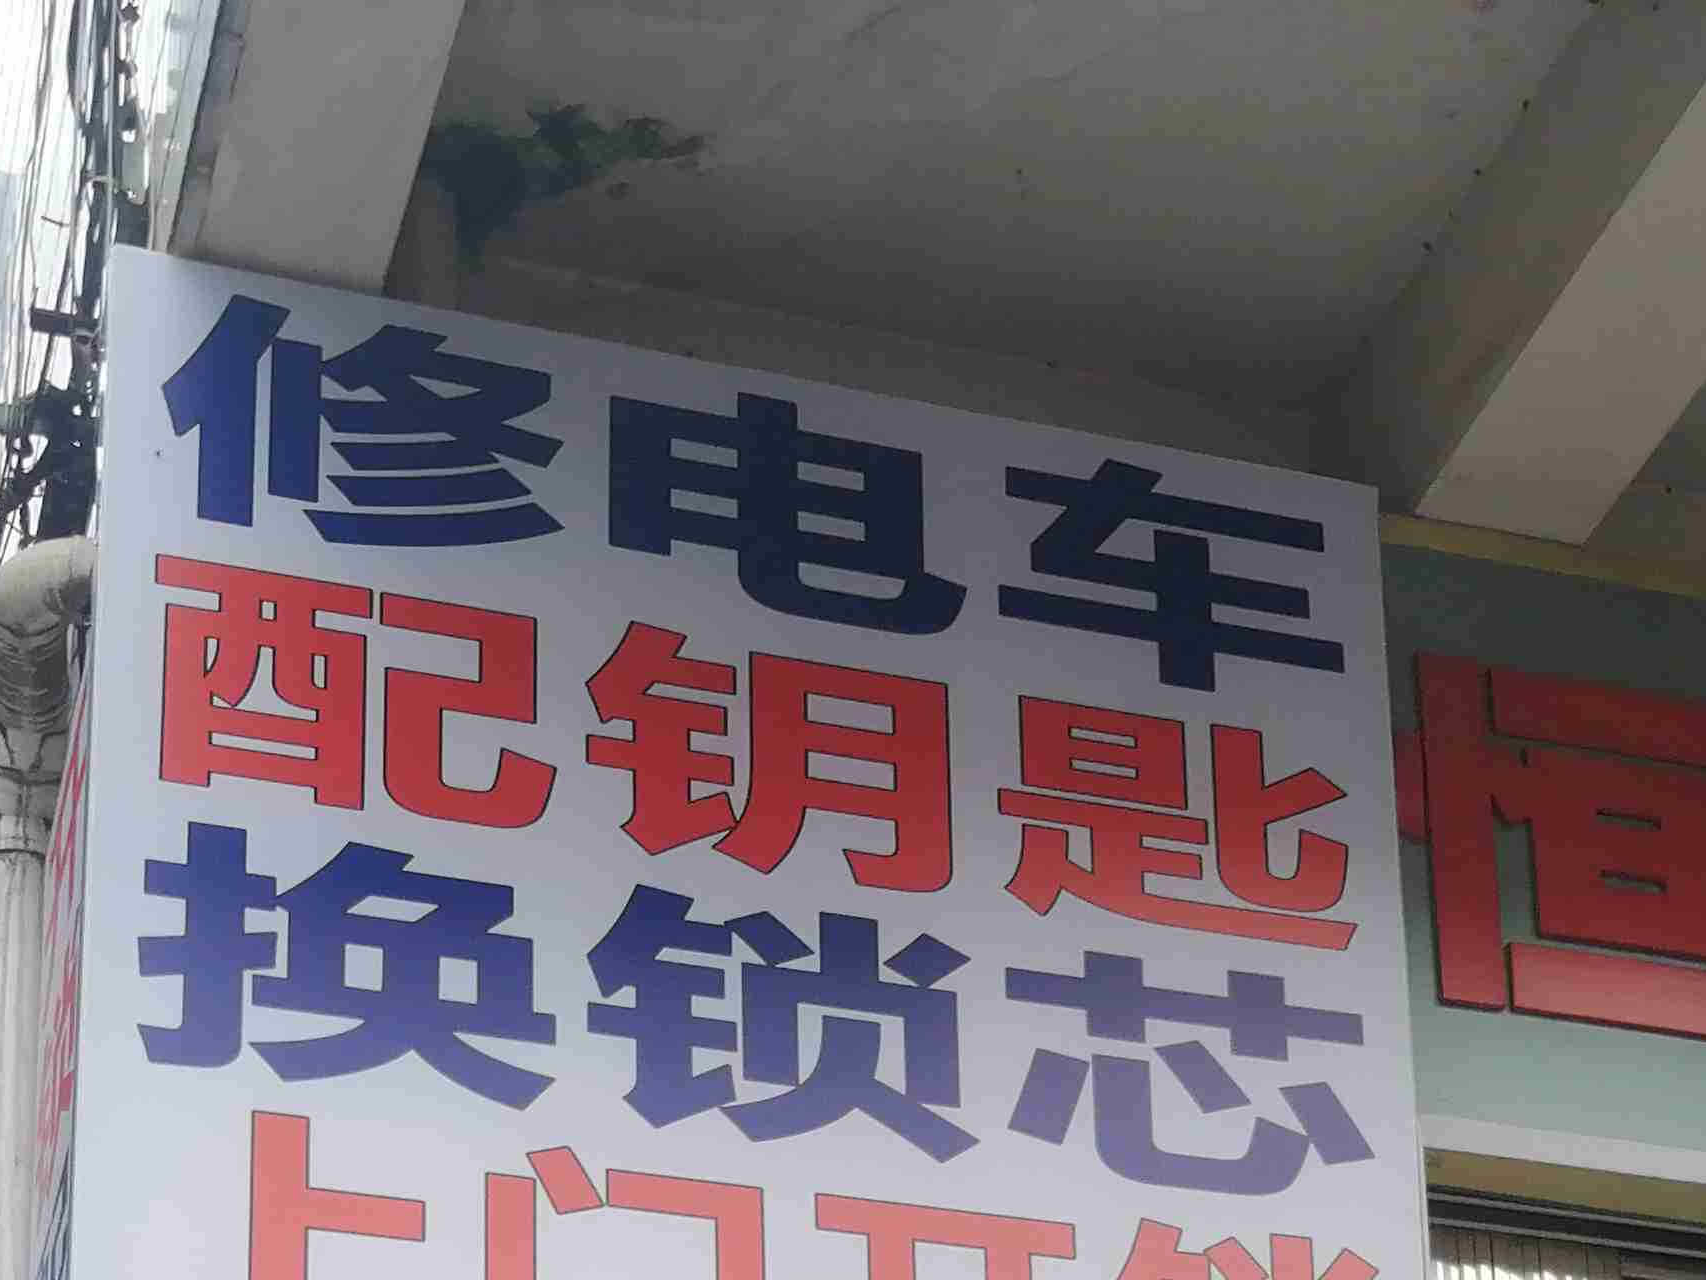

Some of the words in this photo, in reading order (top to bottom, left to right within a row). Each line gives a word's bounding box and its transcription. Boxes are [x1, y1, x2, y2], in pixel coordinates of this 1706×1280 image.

[160, 293, 1346, 693] 修电车
[154, 553, 1359, 951] 配钥匙
[137, 821, 1375, 1197] 换锁芯
